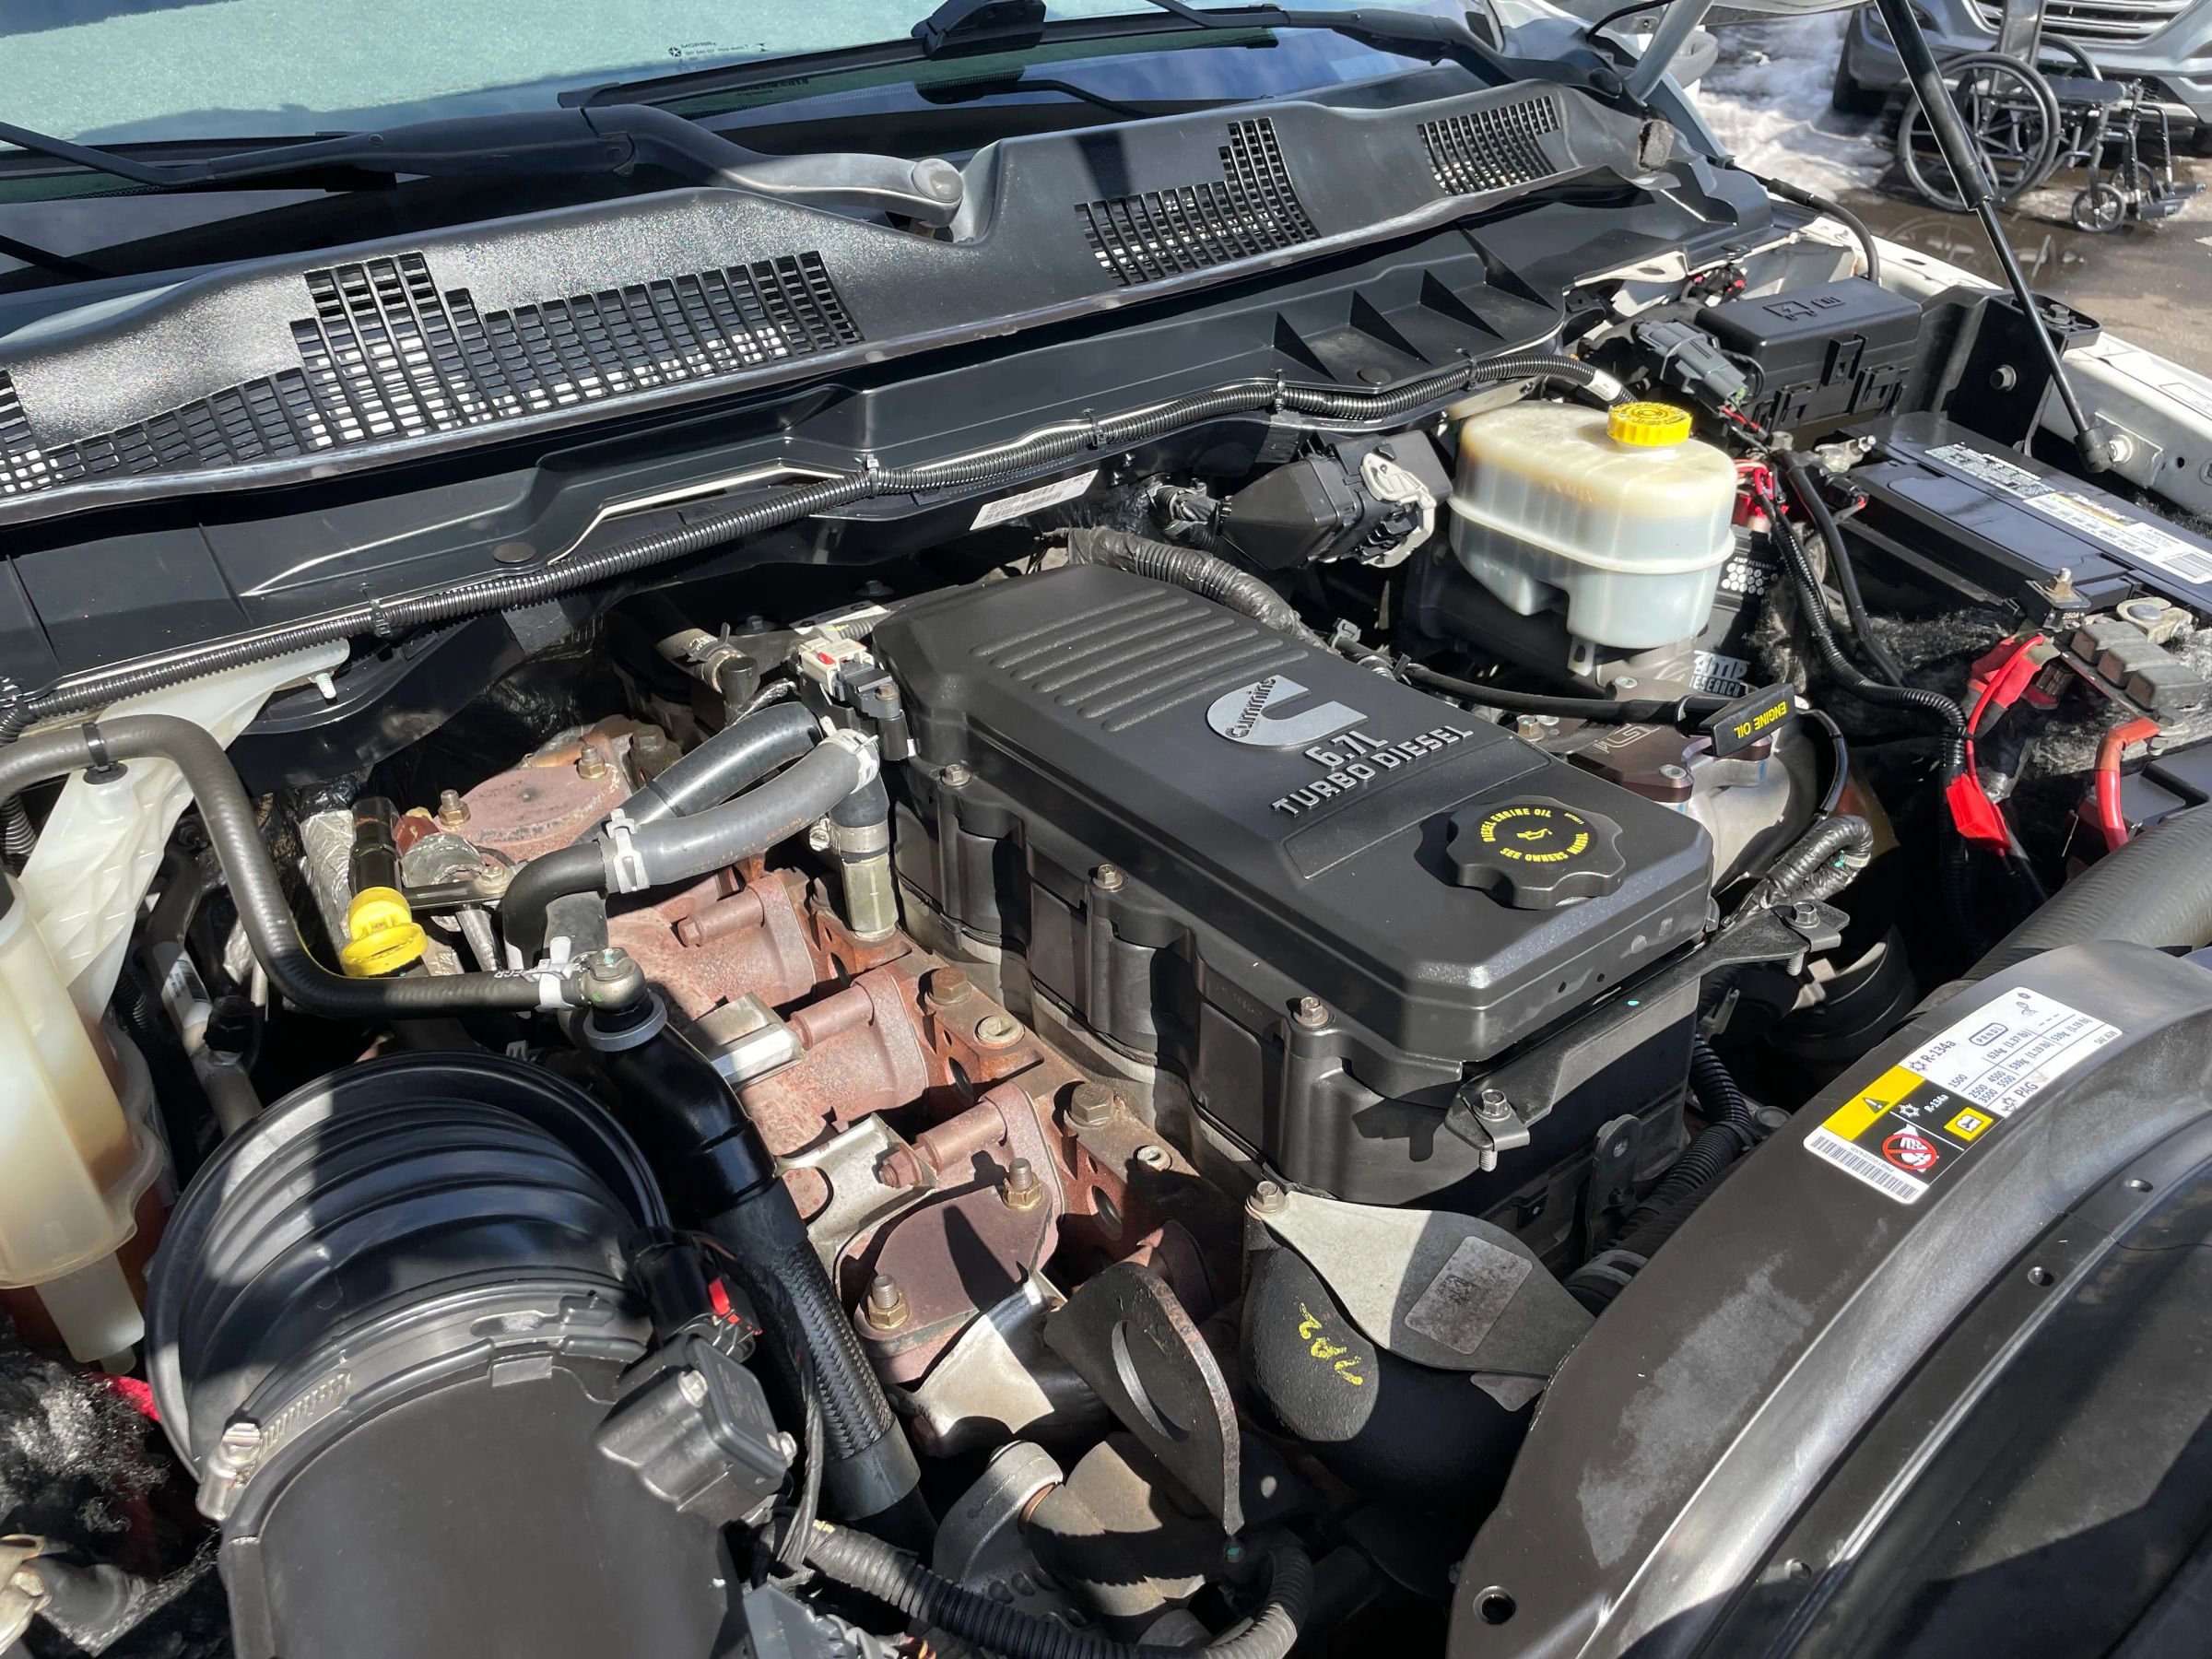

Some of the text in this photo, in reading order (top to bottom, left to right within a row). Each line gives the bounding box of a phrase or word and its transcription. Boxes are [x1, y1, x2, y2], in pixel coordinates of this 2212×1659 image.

[1225, 677, 1277, 738] Cummins
[1733, 700, 1787, 739] ENGINE OIL
[1303, 730, 1389, 770] 6.7L
[1269, 724, 1474, 818] TURBO DIESEL
[1480, 807, 1552, 842] DIESEL ENGINE OIL
[1500, 847, 1523, 860] SEE
[1566, 832, 1589, 855] MANUAL
[1924, 1040, 1957, 1064] R-134a
[1947, 1074, 1969, 1088] 1500
[2003, 1033, 2019, 1049] (1.37
[2018, 1028, 2033, 1041] lb)
[1968, 1084, 1989, 1099] 2500
[1987, 1070, 2007, 1083] 4500
[2008, 1057, 2030, 1071] 539g
[2025, 1045, 2042, 1060] (1.19
[2040, 1040, 2054, 1053] lb)
[2065, 1019, 2083, 1032] (1.19
[2080, 1017, 2094, 1027] lb)
[1924, 1094, 1950, 1113] R-134a
[1980, 1075, 2018, 1104] 3500 5500
[2013, 1082, 2040, 1099] PAG
